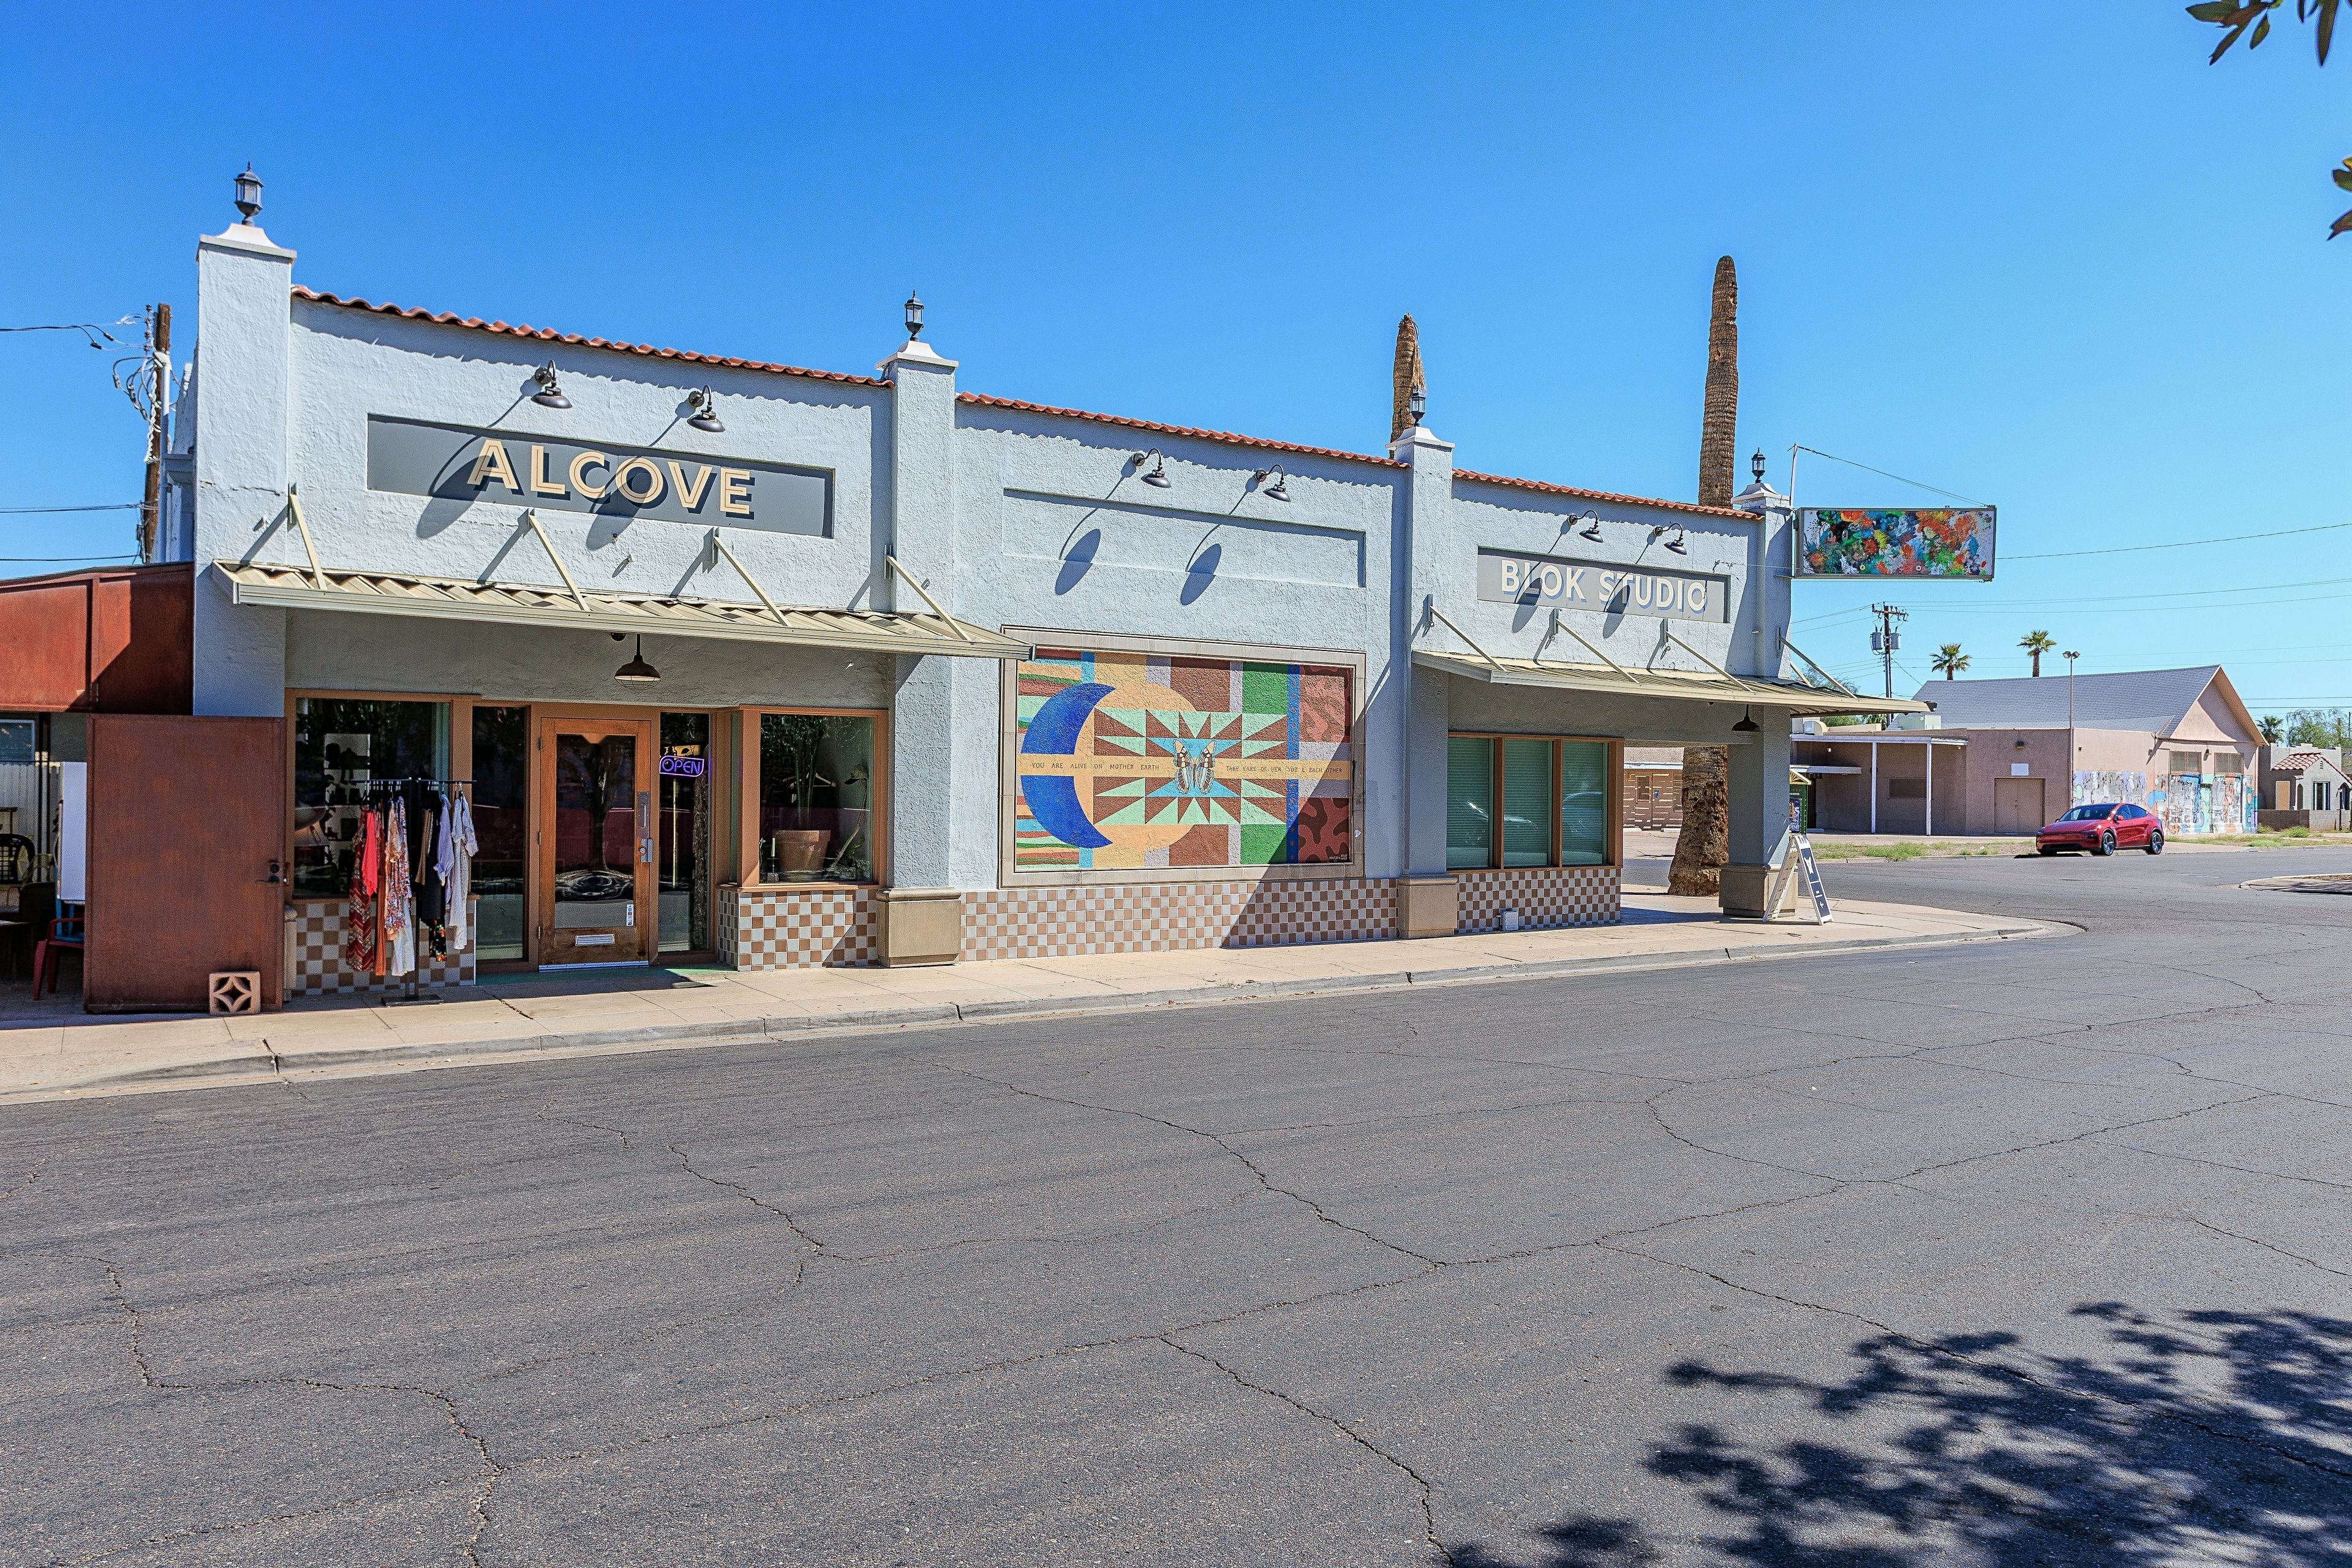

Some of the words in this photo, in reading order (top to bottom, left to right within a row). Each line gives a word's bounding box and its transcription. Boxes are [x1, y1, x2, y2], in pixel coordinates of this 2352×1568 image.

[467, 439, 752, 516] ALCOVE
[1501, 559, 1585, 600] BLOK
[1598, 571, 1707, 611] STUDIO
[662, 758, 701, 774] OPEN
